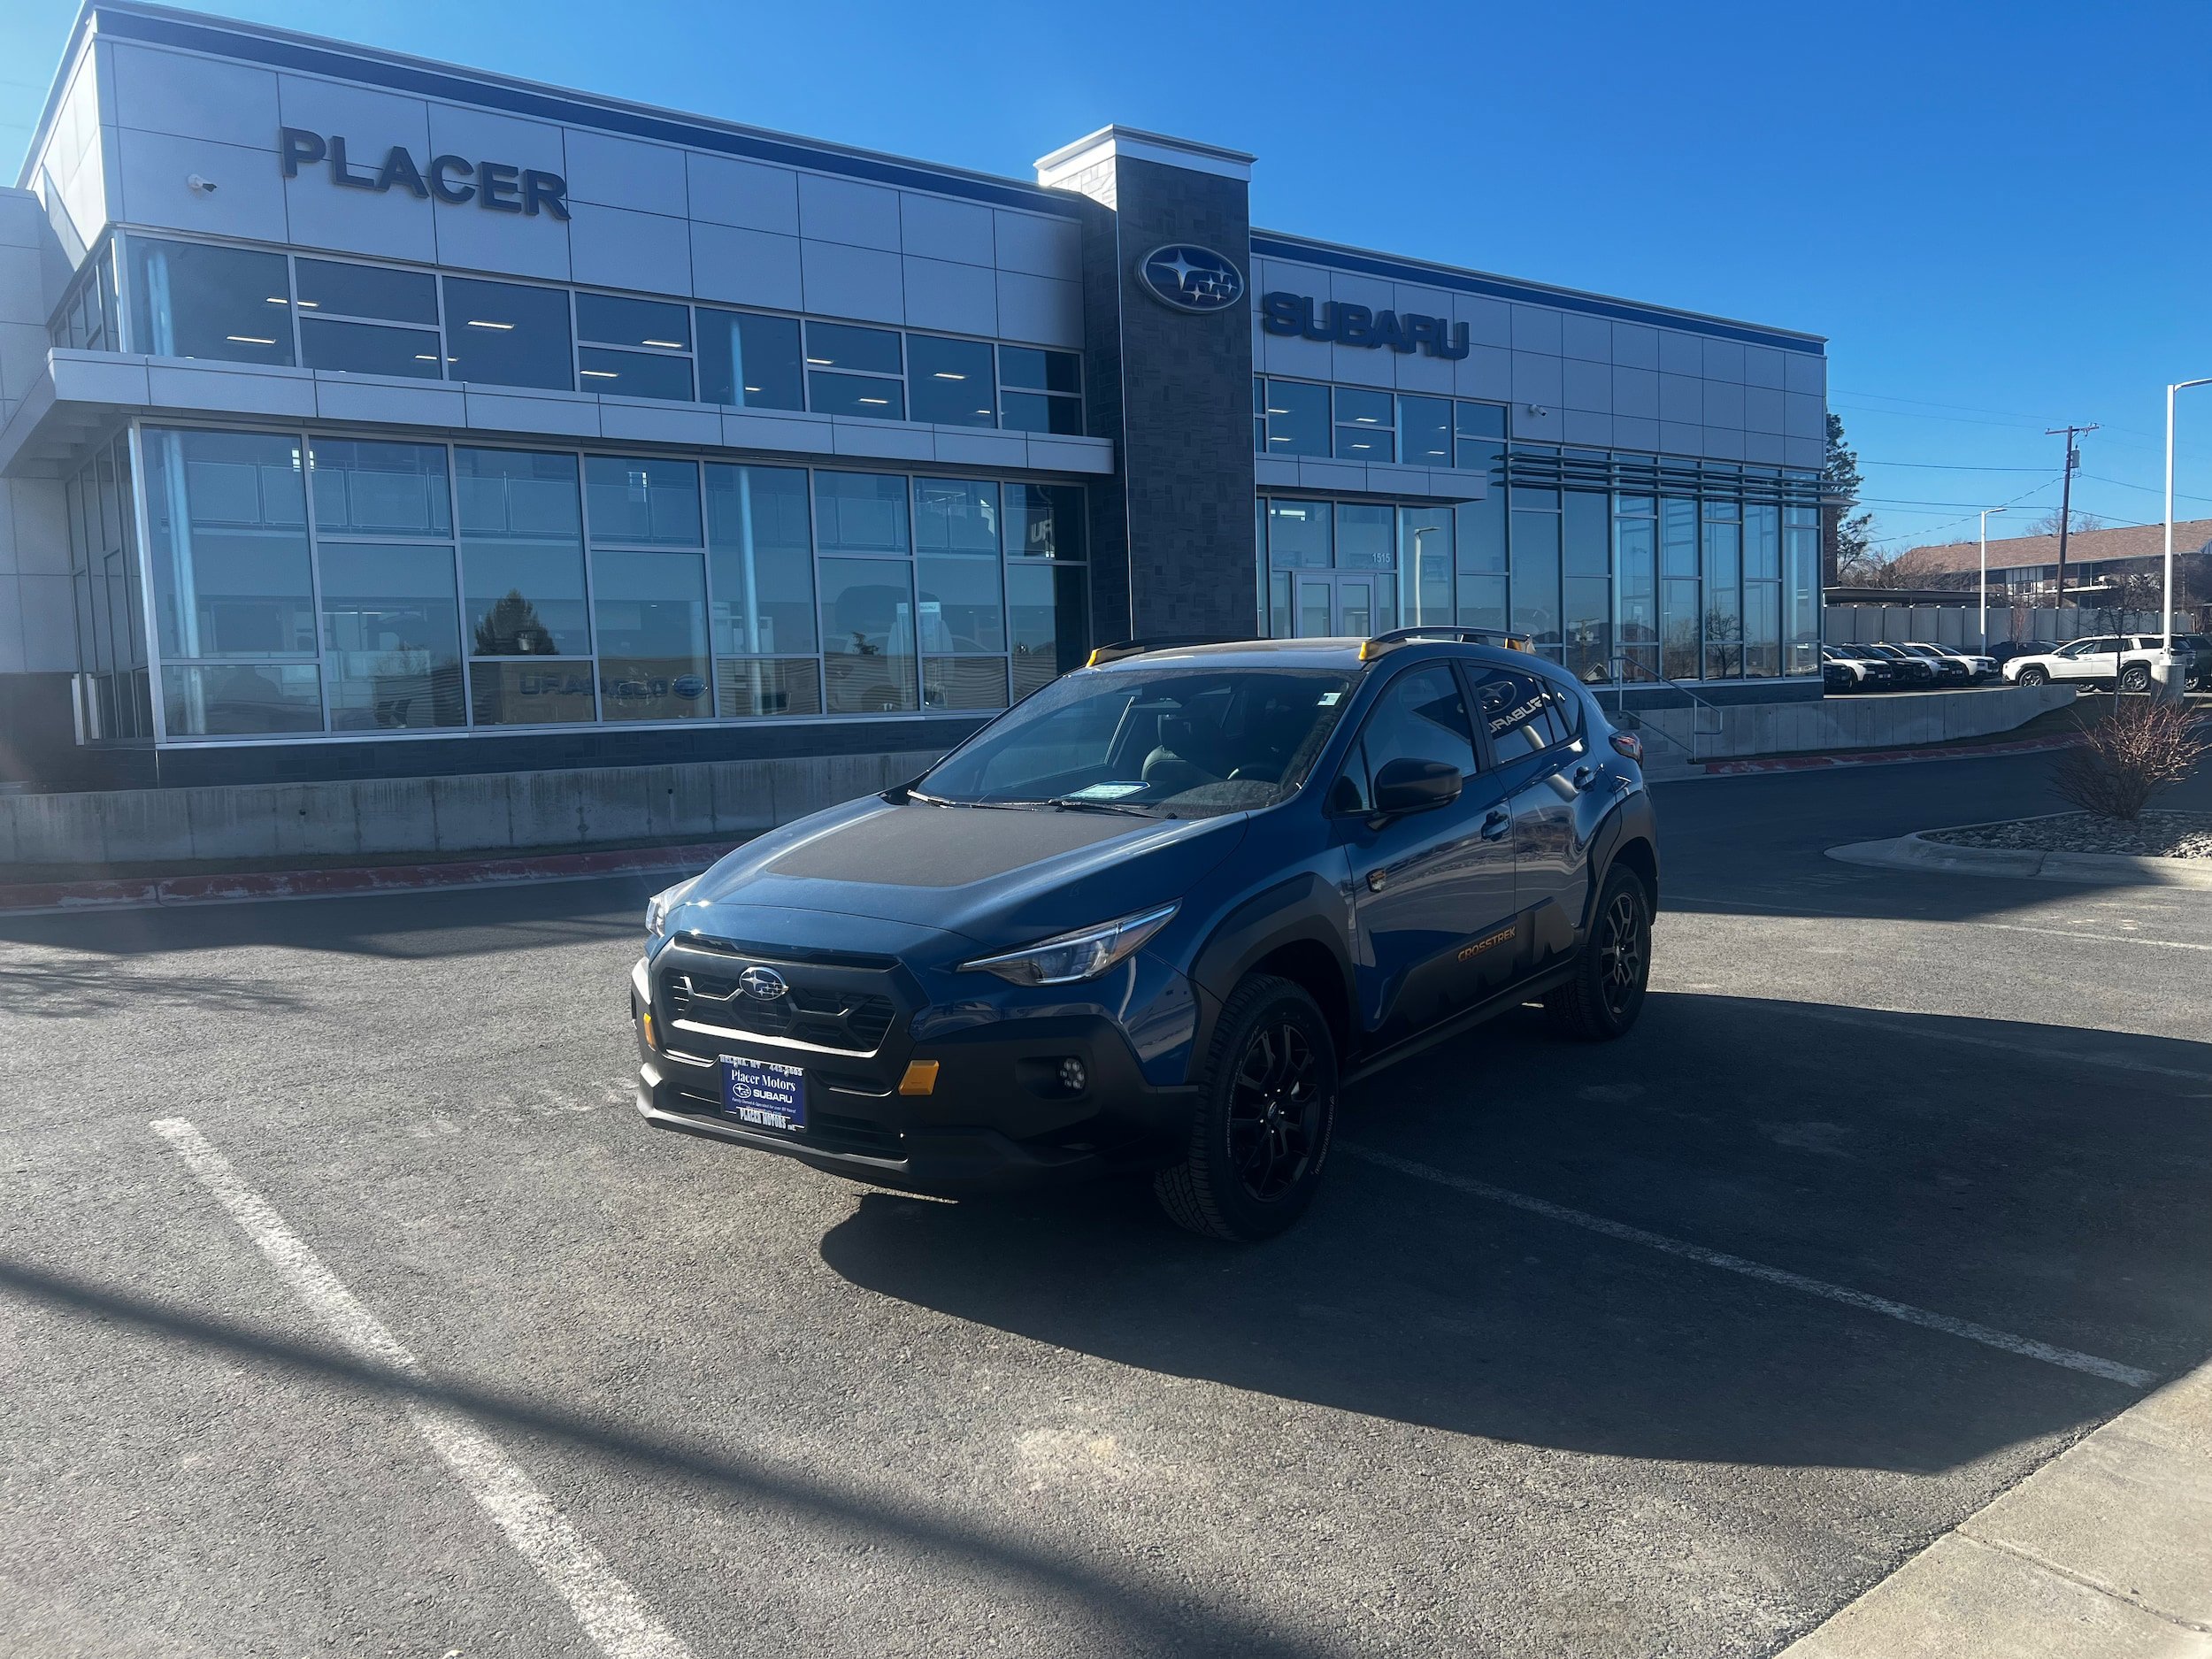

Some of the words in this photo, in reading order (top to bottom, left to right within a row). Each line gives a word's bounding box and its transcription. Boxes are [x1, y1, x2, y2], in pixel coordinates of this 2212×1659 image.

[279, 127, 571, 221] PLACER
[1263, 290, 1470, 360] SUBARU
[1371, 552, 1391, 563] 1515
[1457, 926, 1516, 963] CROSSTREK
[731, 1070, 760, 1086] Placer
[762, 1075, 796, 1092] Motors
[753, 1088, 793, 1104] SUBARU
[740, 1109, 762, 1124] PLACER
[763, 1112, 786, 1129] MOTORS
